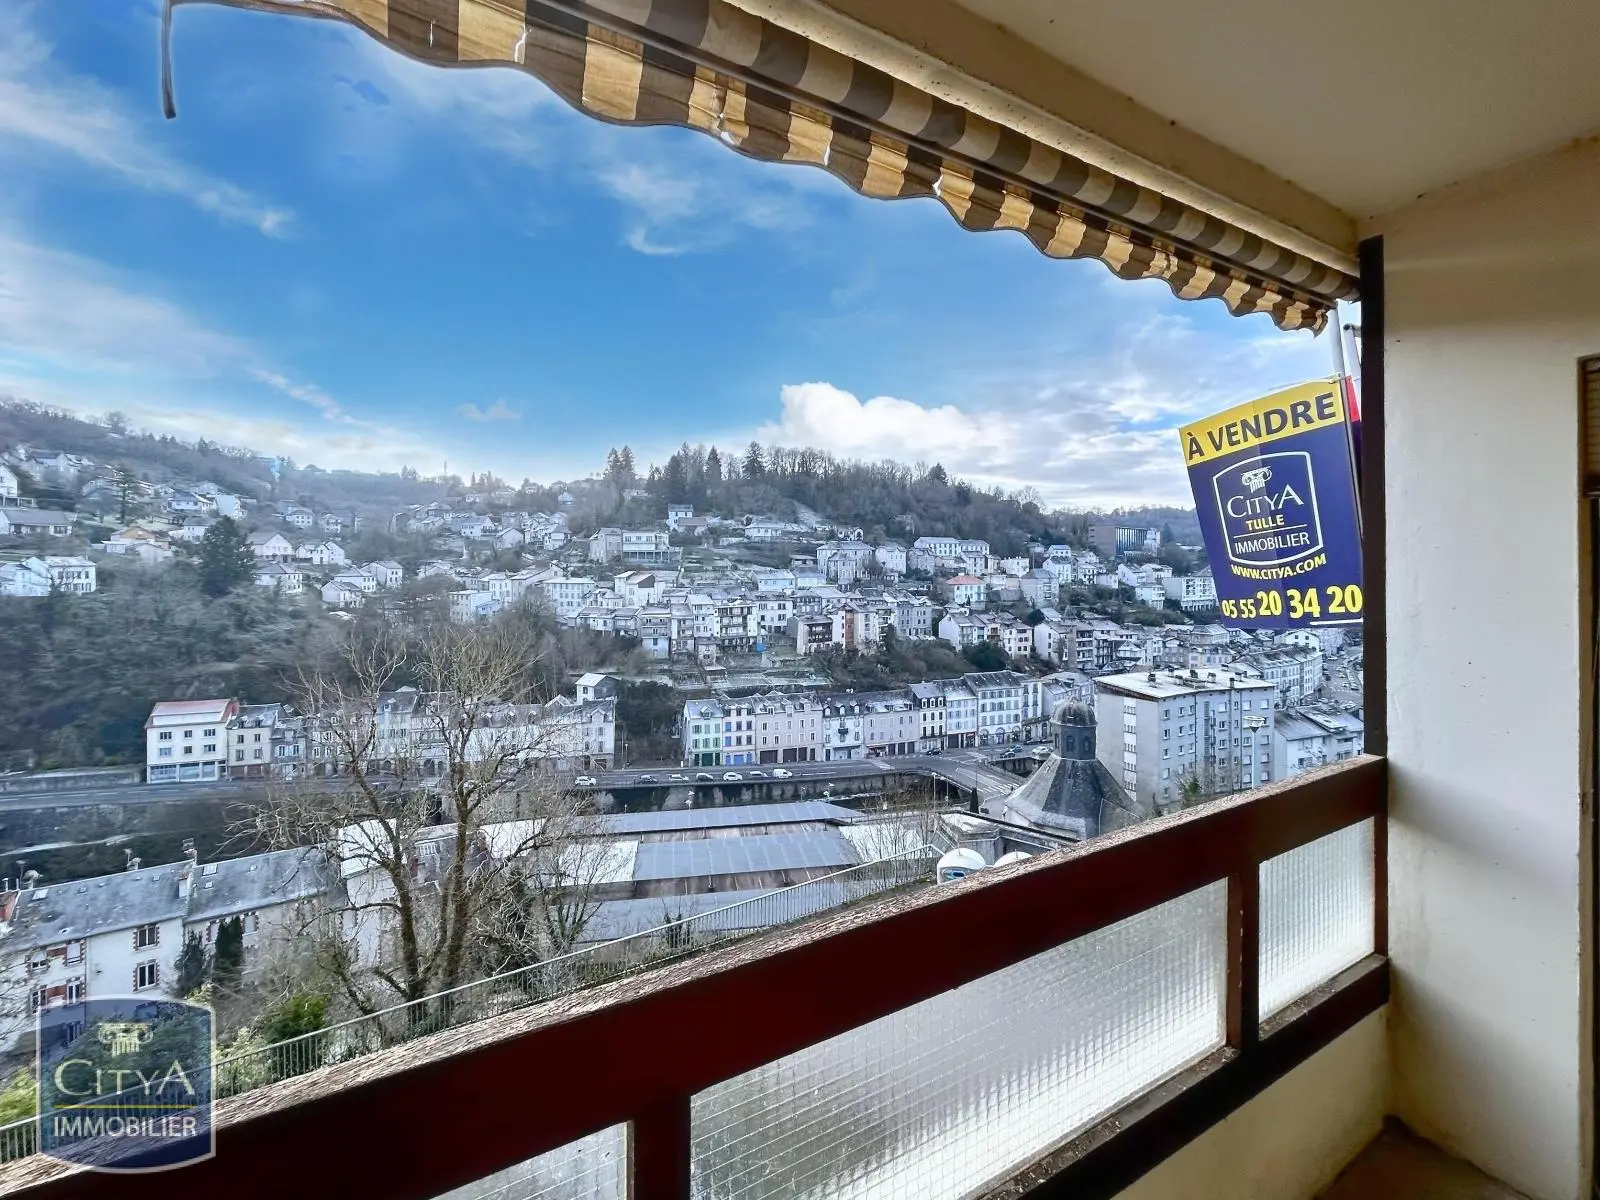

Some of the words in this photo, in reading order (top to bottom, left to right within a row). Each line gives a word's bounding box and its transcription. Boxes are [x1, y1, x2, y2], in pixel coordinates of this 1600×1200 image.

[1188, 431, 1205, 461] À
[1206, 392, 1337, 452] VENDRE
[1245, 513, 1285, 531] TULLE
[1234, 531, 1310, 555] IMMOBILIER
[1230, 552, 1327, 580] WWW.CITYA.COM
[1222, 599, 1237, 618] 05
[1240, 598, 1257, 619] 55
[1256, 591, 1282, 616] 20
[1289, 587, 1321, 619] 34
[1326, 584, 1363, 614] 20
